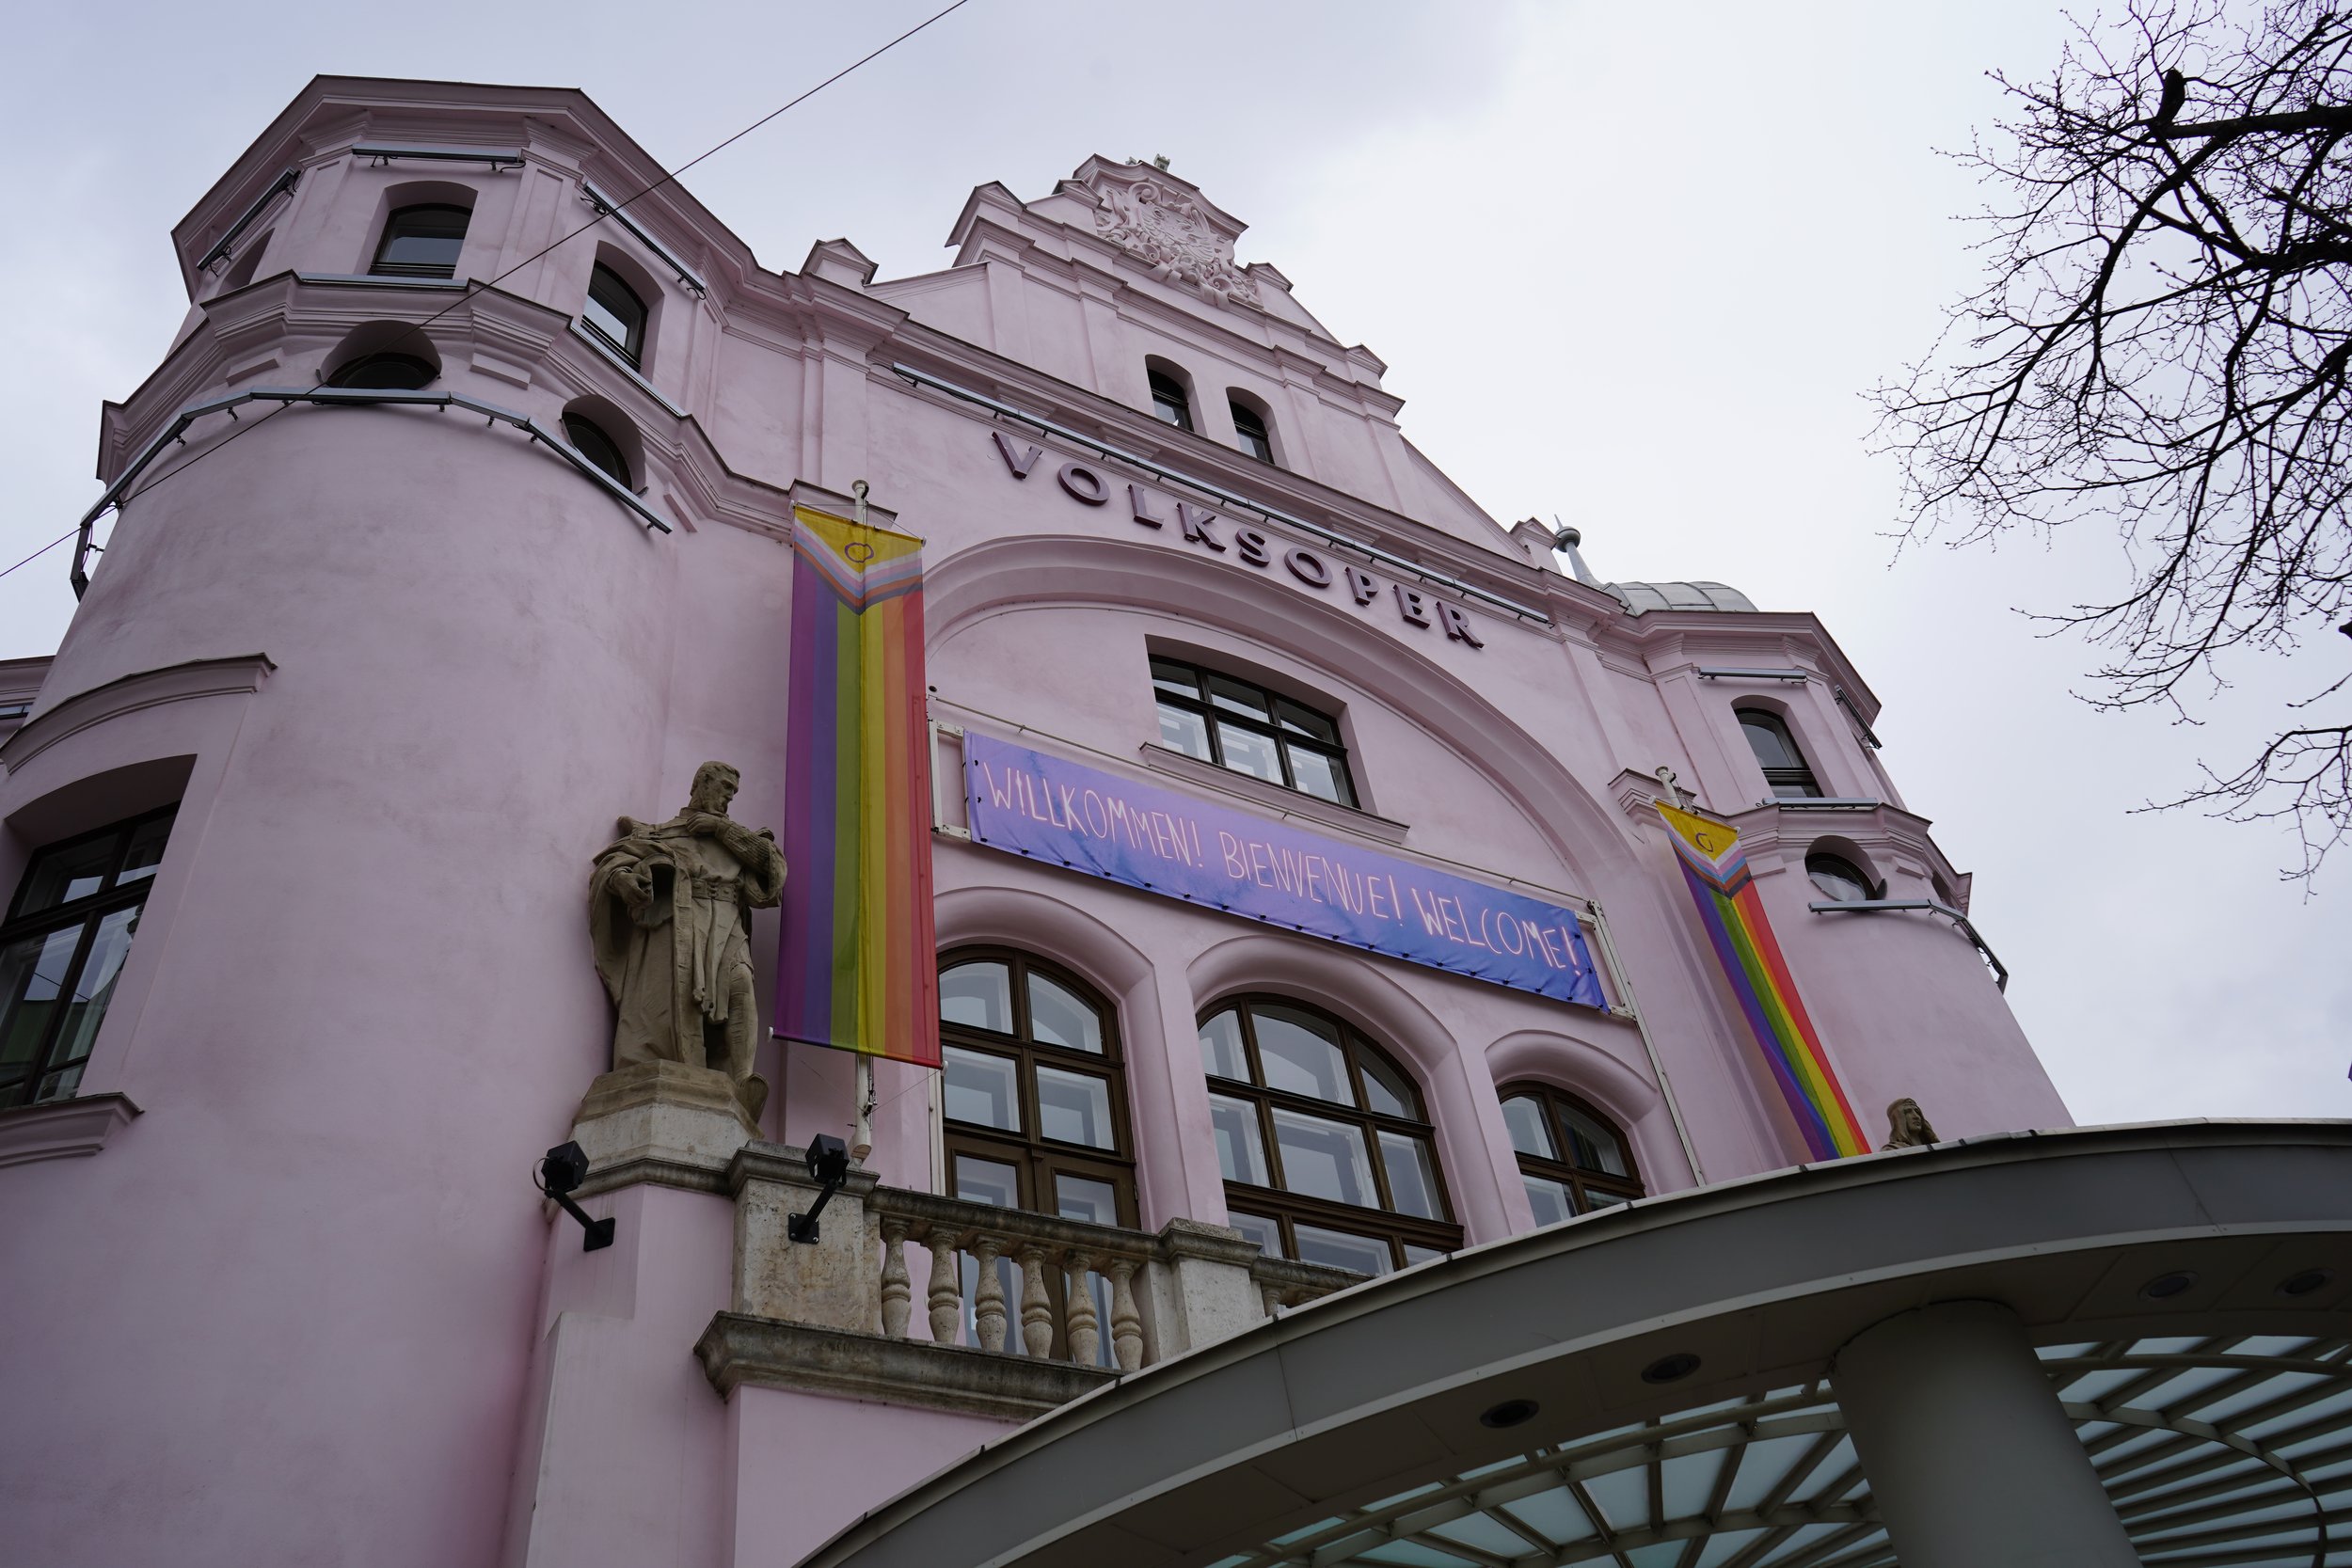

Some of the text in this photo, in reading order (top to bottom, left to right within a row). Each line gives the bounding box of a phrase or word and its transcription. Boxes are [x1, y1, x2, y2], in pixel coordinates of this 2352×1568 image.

[991, 431, 1486, 649] VOLKSOPER
[983, 762, 1581, 976] WILLKOMMEN! BIENVENUE! WELCOME!
